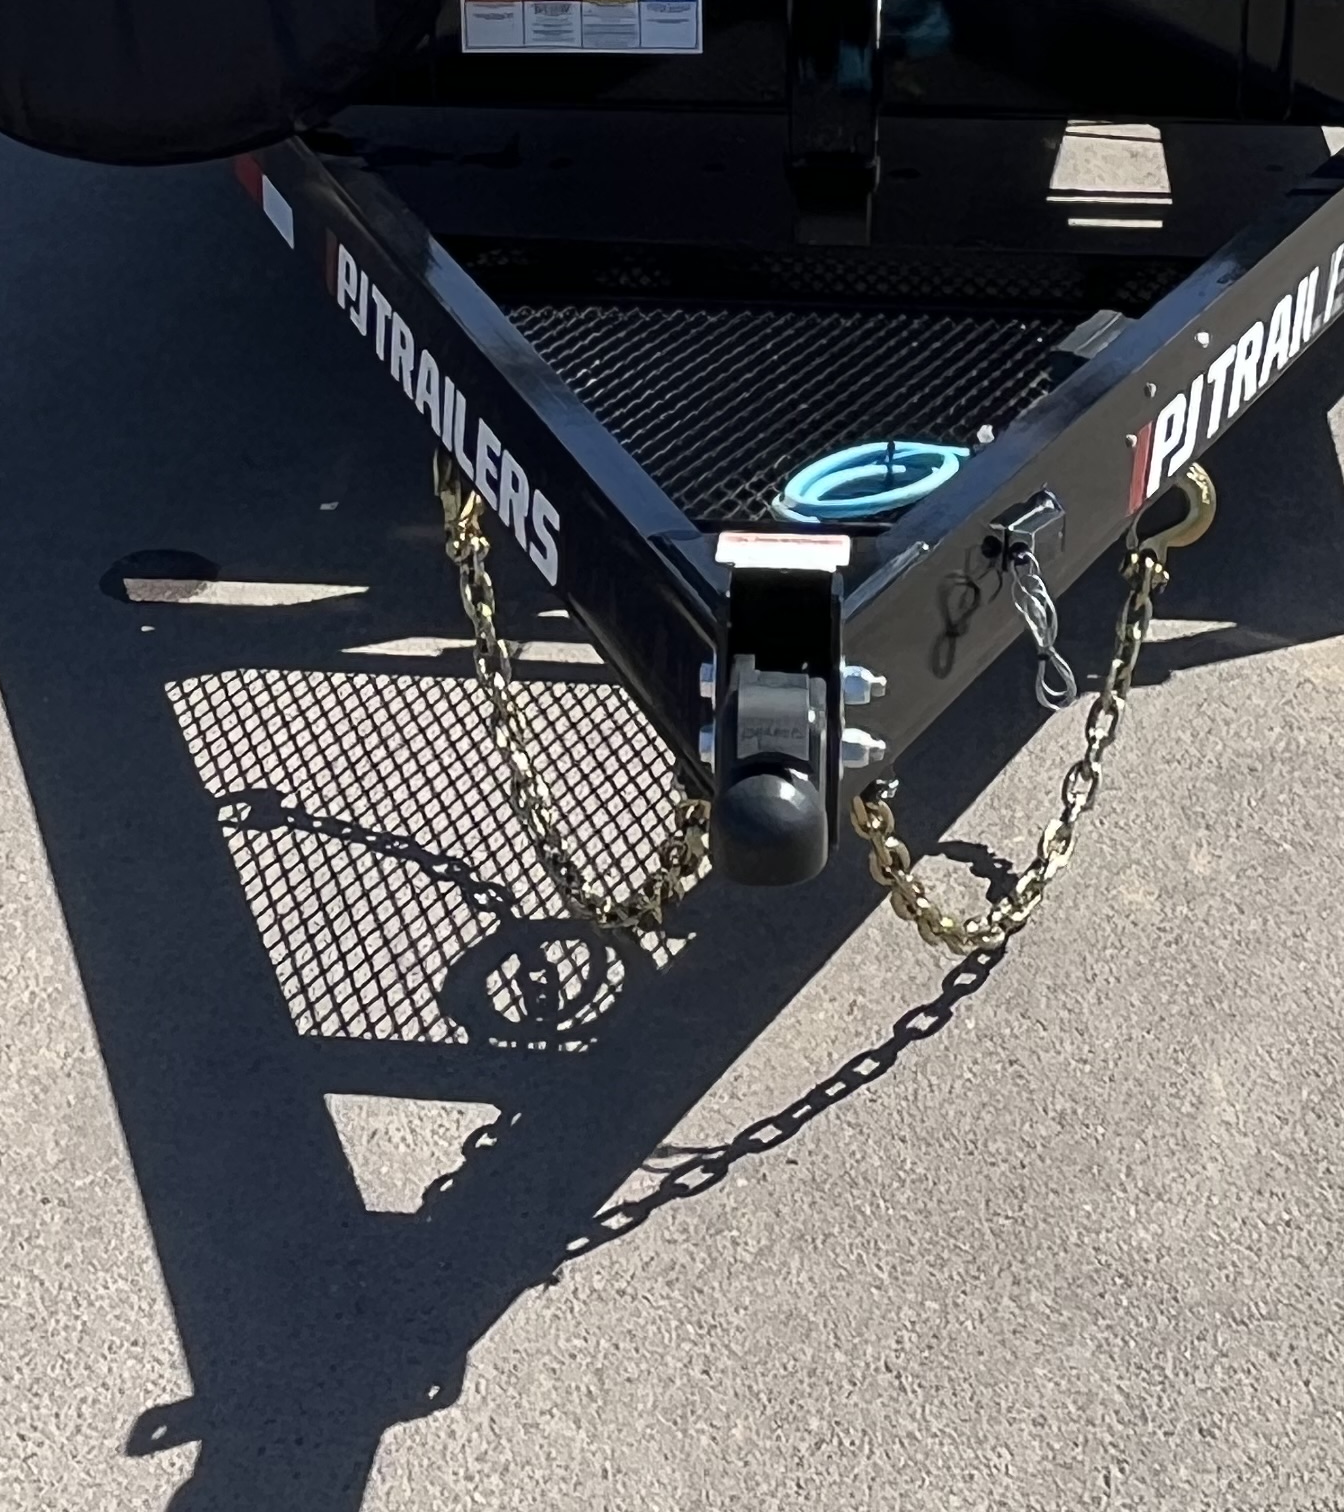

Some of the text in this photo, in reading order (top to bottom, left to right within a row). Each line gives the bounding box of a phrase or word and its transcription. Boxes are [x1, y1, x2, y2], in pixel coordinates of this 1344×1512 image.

[336, 243, 560, 587] PJ TRAILERS
[1146, 373, 1205, 499] PJ
